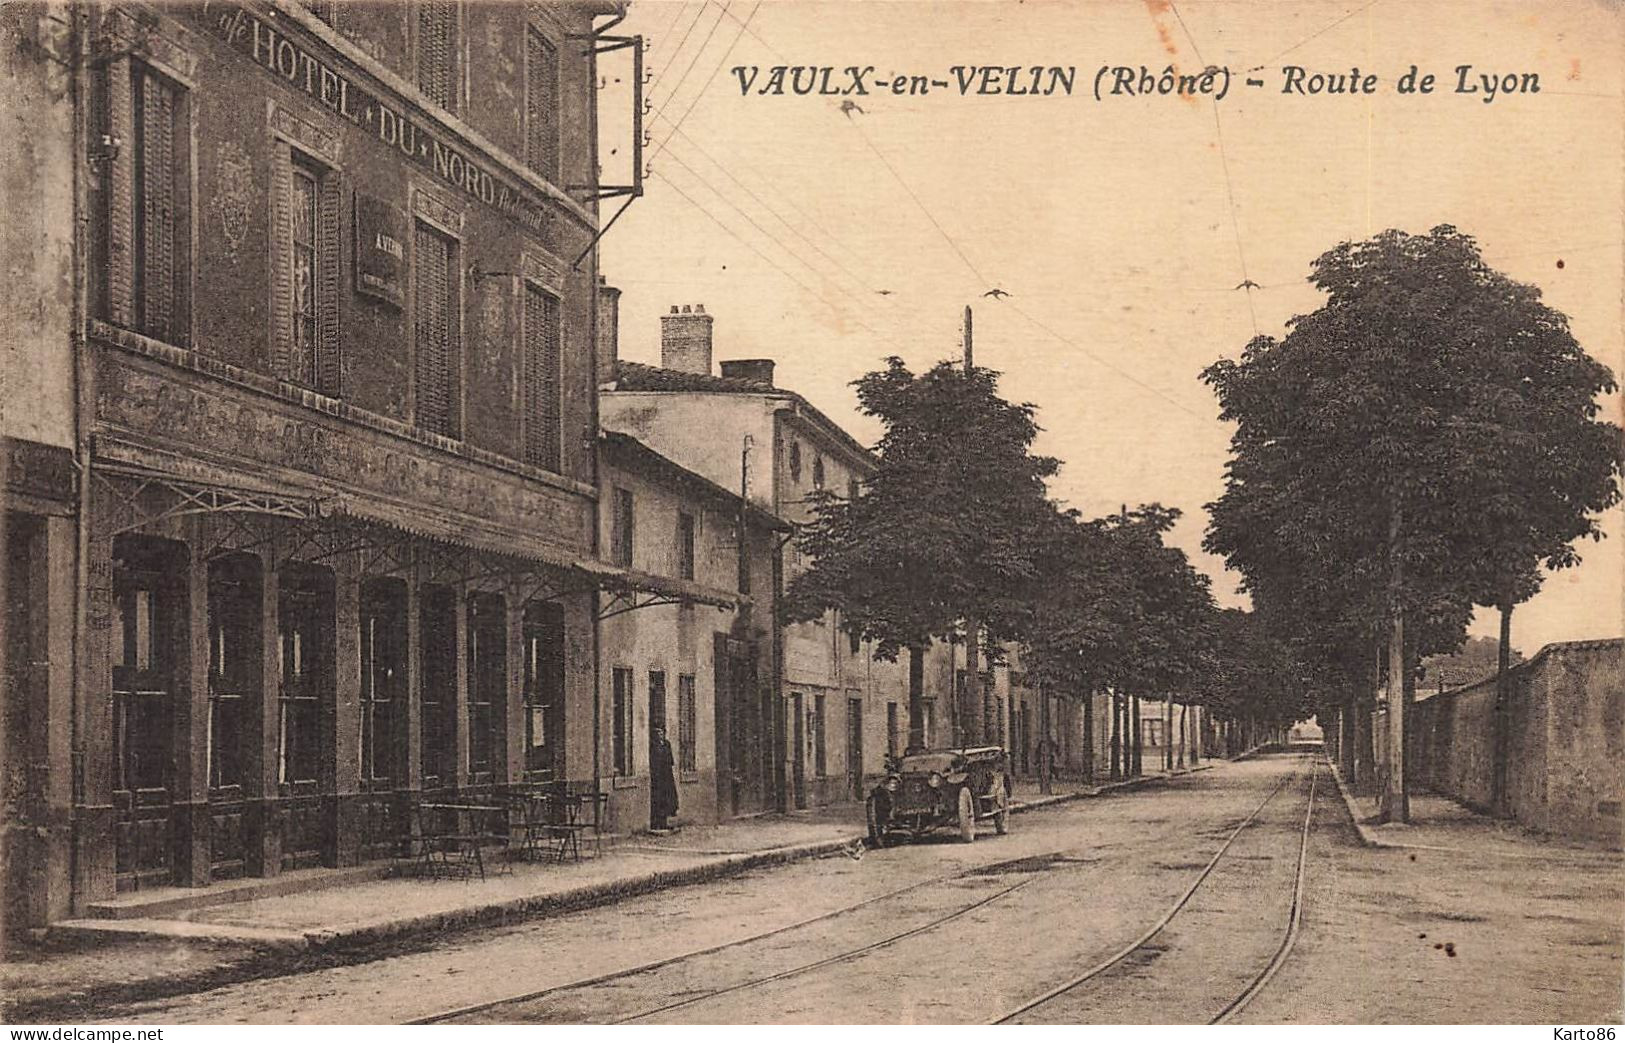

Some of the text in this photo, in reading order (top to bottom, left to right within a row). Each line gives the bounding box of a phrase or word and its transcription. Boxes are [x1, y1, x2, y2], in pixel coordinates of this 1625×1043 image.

[252, 20, 359, 121] HOTEL
[379, 105, 417, 156] DU
[433, 140, 495, 205] NORD
